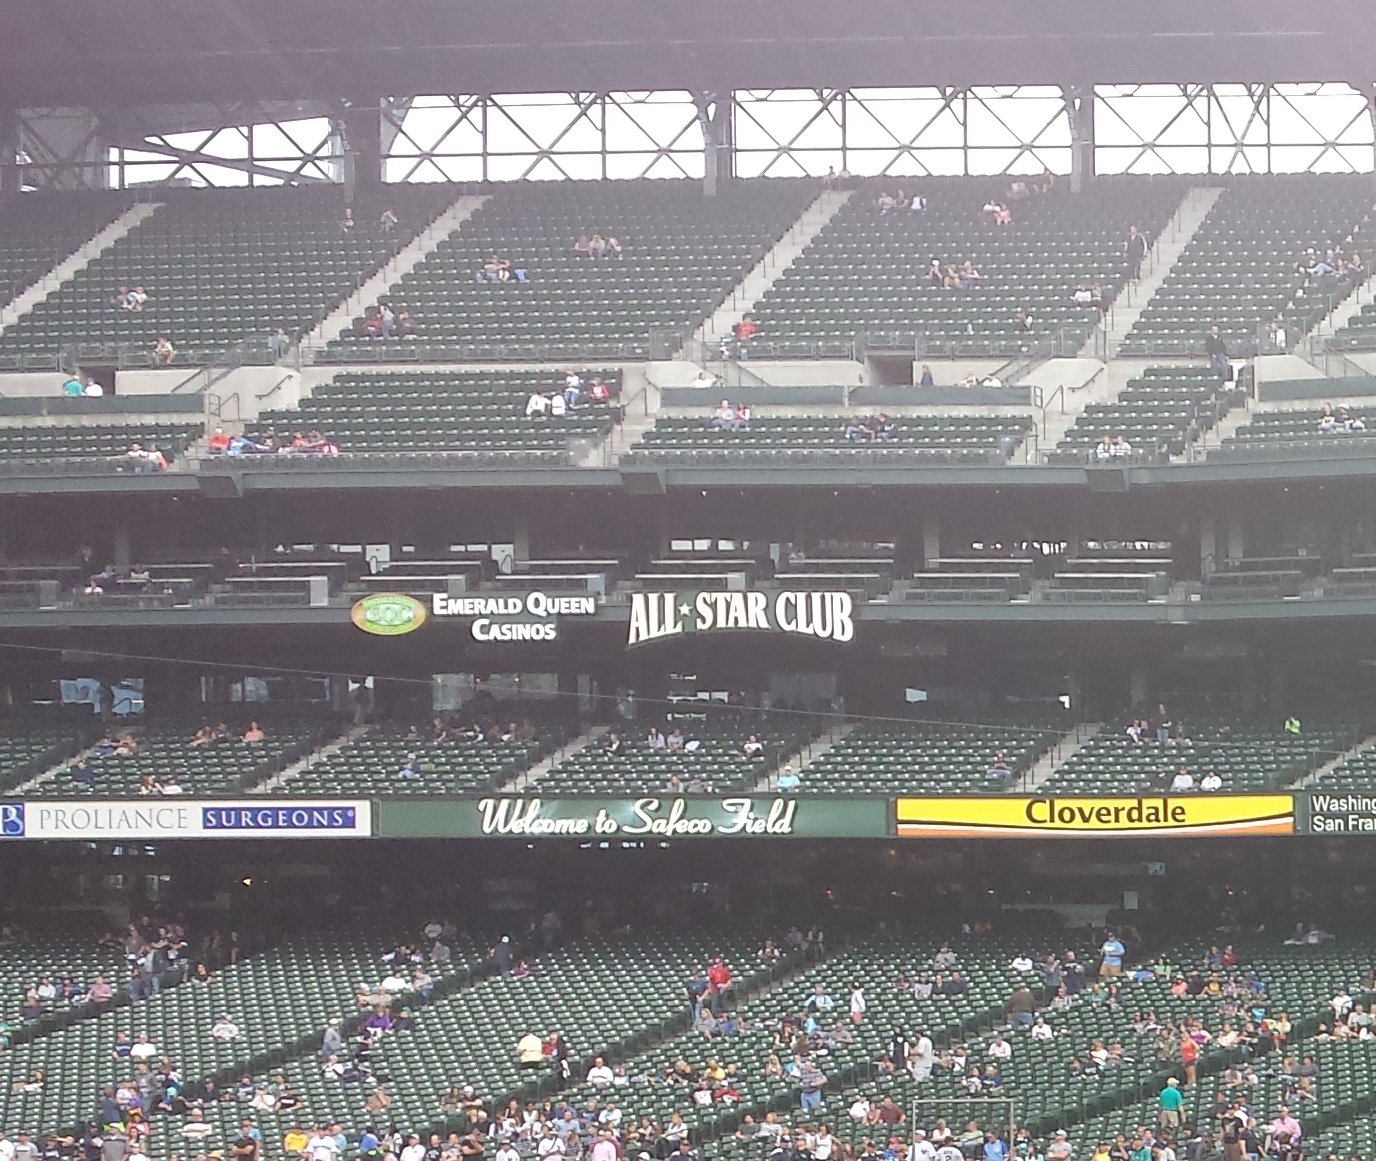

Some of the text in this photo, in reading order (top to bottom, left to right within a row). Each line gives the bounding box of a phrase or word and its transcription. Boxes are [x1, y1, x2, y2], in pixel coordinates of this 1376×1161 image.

[433, 593, 521, 615] EMERALD
[526, 591, 596, 616] QUEEN
[472, 618, 557, 641] CASINOS
[775, 591, 855, 643] CLUB
[39, 808, 345, 830] PROLIANCE SURGEONS
[477, 798, 797, 836] Welcome to Safeco Field
[1025, 798, 1187, 824] Cloverdale
[1312, 815, 1346, 832] San
